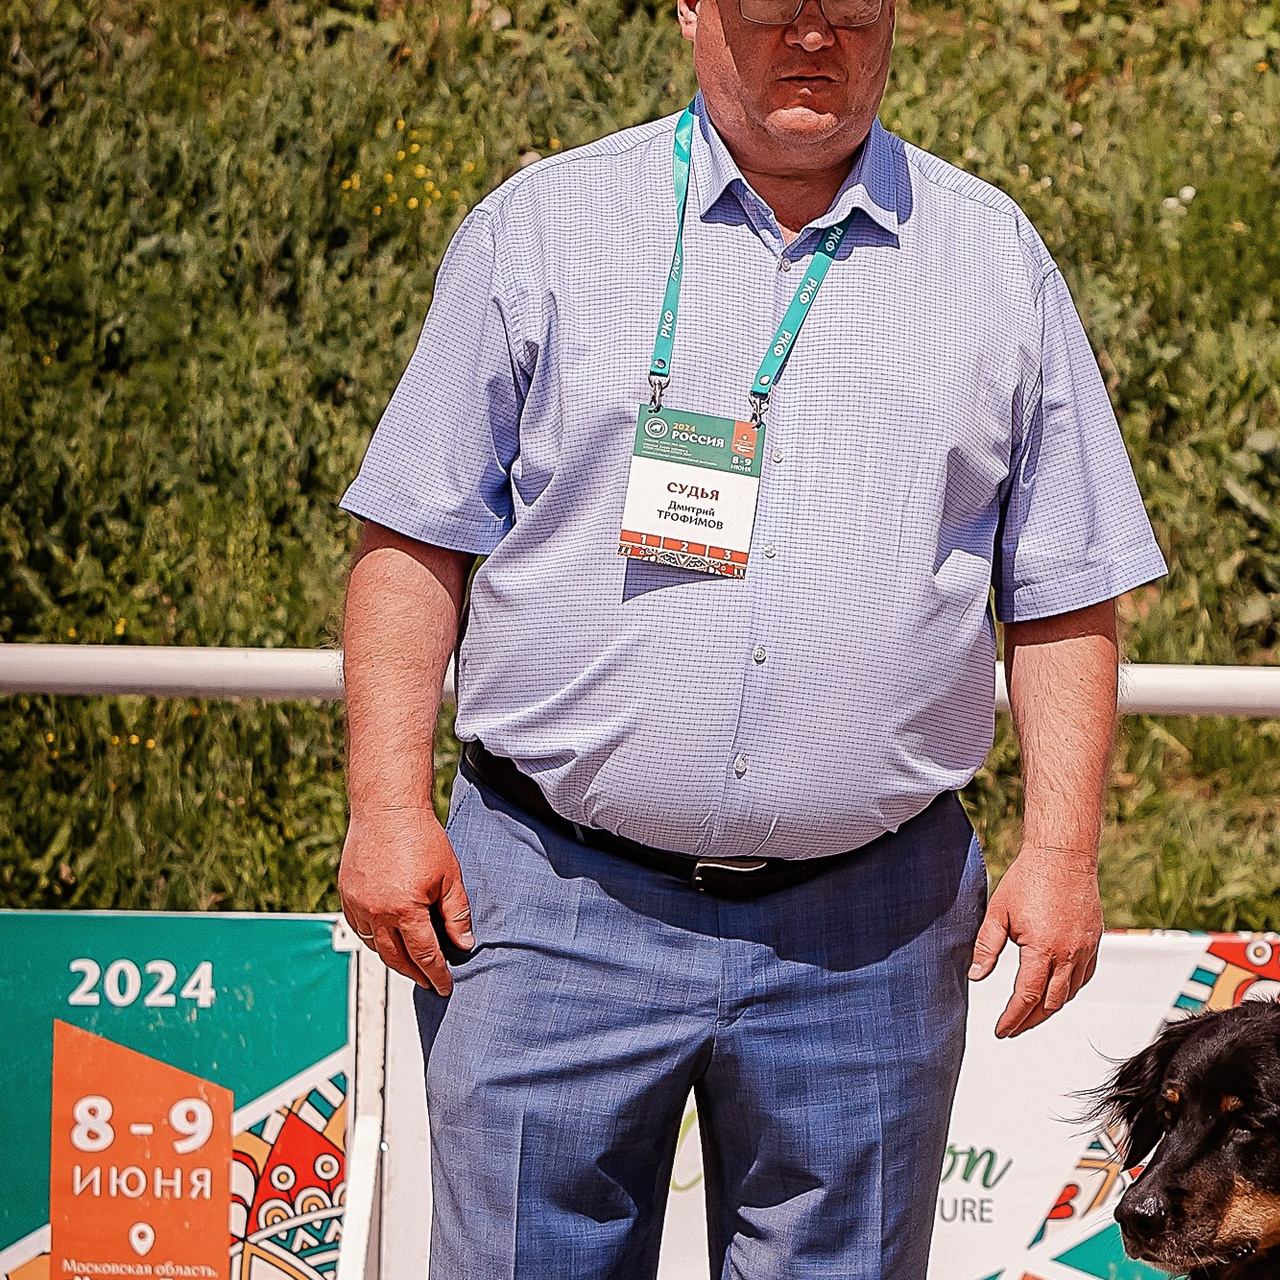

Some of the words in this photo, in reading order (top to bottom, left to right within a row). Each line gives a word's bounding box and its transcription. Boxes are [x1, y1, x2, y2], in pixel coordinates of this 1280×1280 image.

[823, 226, 844, 253] РКФ
[799, 276, 818, 305] РКФ
[659, 309, 676, 339] РКФ
[773, 329, 793, 357] РКФ
[671, 430, 725, 449] РОССИЯ
[673, 422, 696, 433] 2024
[666, 481, 720, 501] СУДЬЯ
[657, 509, 724, 530] ТРОФИМОВ
[667, 500, 715, 517] Дмитрий
[640, 533, 648, 545] 1
[680, 541, 689, 552] 2
[723, 549, 732, 560] 3
[68, 957, 216, 1008] 2024
[72, 1165, 213, 1200] ИЮНЯ
[61, 1258, 152, 1276] Московская
